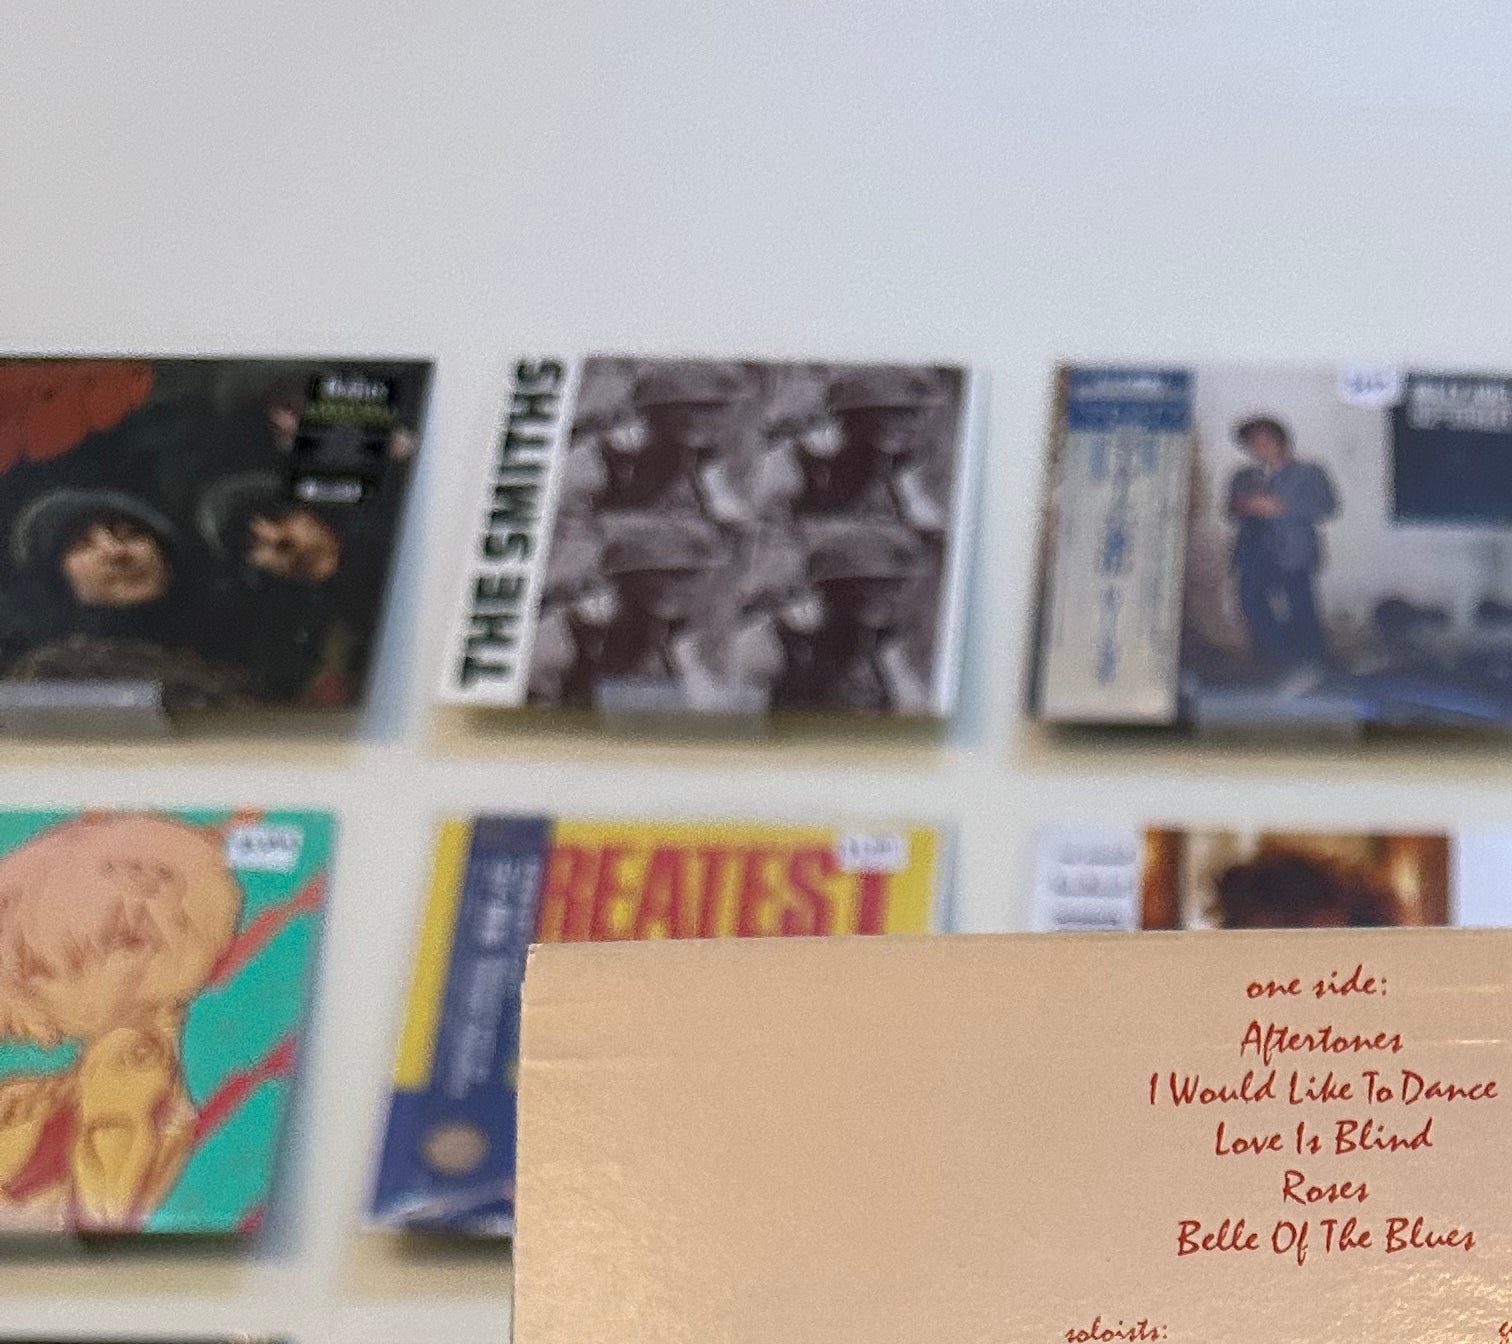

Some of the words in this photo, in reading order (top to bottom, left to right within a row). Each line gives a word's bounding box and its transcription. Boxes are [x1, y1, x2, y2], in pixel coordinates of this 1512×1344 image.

[483, 359, 564, 562] SMITHS
[460, 575, 526, 688] THE
[1247, 978, 1300, 998] one
[1316, 964, 1387, 997] side:
[1240, 1020, 1403, 1065] Aftertones
[1149, 1072, 1159, 1104] I
[1170, 1070, 1276, 1105] Would
[1289, 1070, 1352, 1104] Like
[1363, 1070, 1394, 1105] To
[1402, 1070, 1498, 1105] Dance
[1216, 1121, 1282, 1156] Love
[1296, 1122, 1320, 1154] Is
[1336, 1117, 1433, 1154] Blind
[1283, 1169, 1368, 1205] Roses
[1177, 1219, 1259, 1256] Belle
[1272, 1221, 1308, 1266] Of
[1320, 1217, 1372, 1253] The
[1385, 1216, 1476, 1253] Blues
[1065, 1316, 1168, 1344] soloists:
